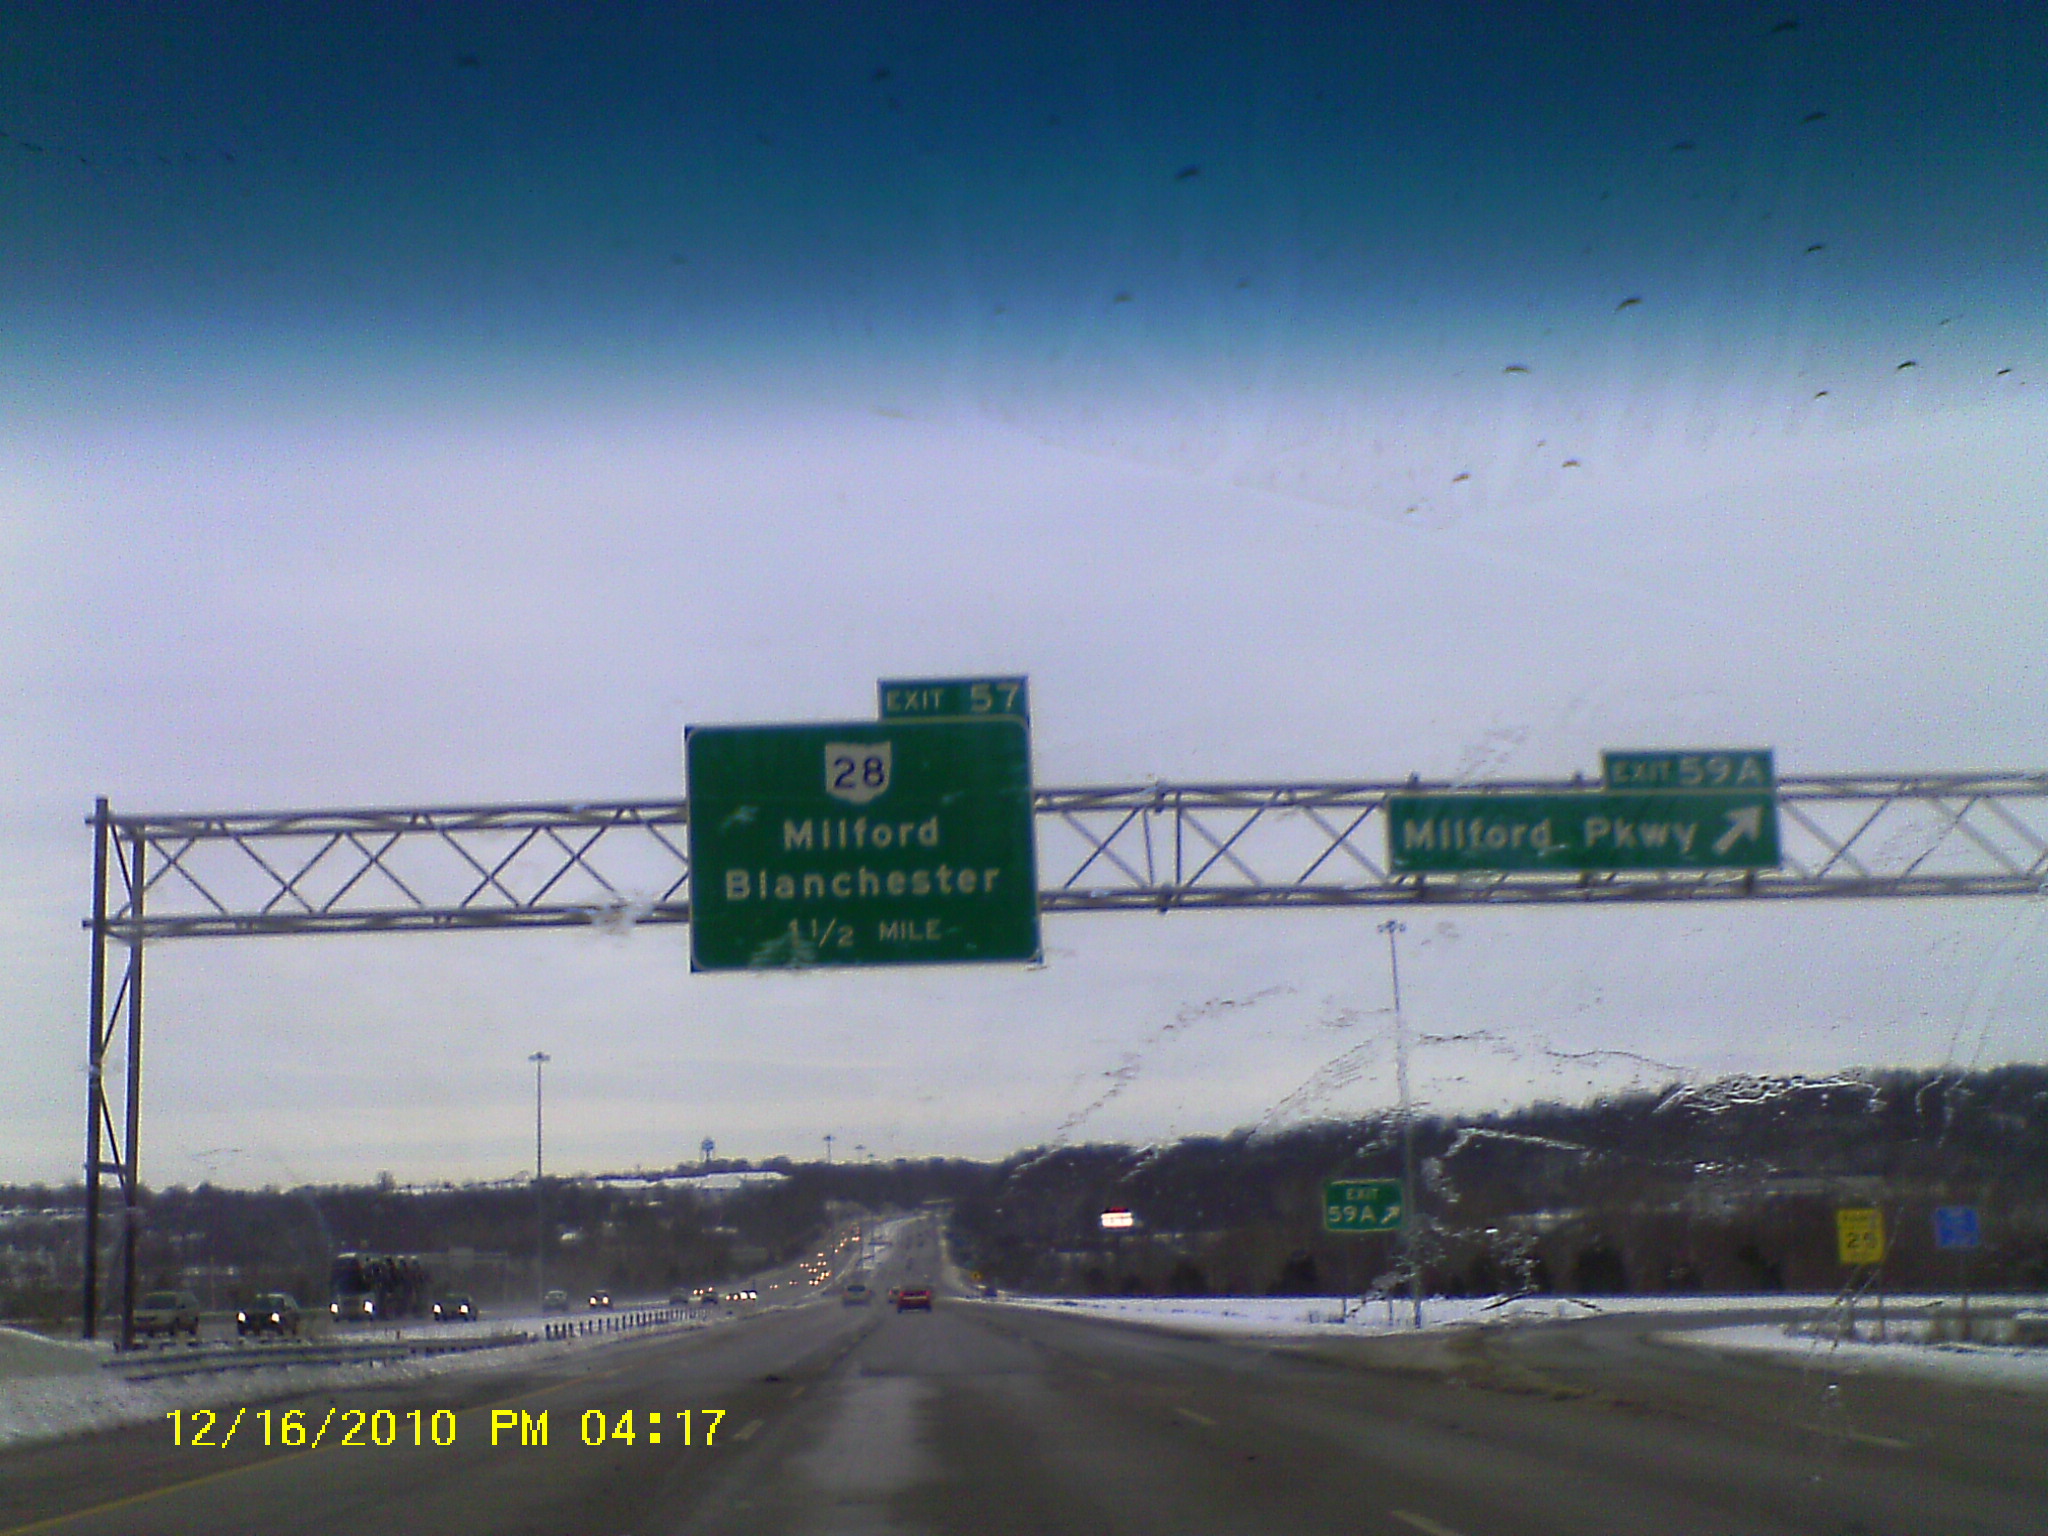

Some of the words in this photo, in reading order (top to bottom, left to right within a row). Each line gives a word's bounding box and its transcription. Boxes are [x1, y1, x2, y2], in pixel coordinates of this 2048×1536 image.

[886, 688, 945, 712] EXIT
[970, 683, 1020, 712] 57
[833, 756, 885, 789] 28
[1613, 760, 1672, 783] EXIT
[1679, 756, 1765, 786] 59A
[783, 816, 939, 850] Milford
[1403, 816, 1553, 850] Milford
[1584, 815, 1699, 854] Pkwy
[725, 863, 1000, 901] Blanchester
[879, 918, 942, 942] MILE
[1346, 1188, 1379, 1201] EXIT
[1328, 1205, 1378, 1223] 59A
